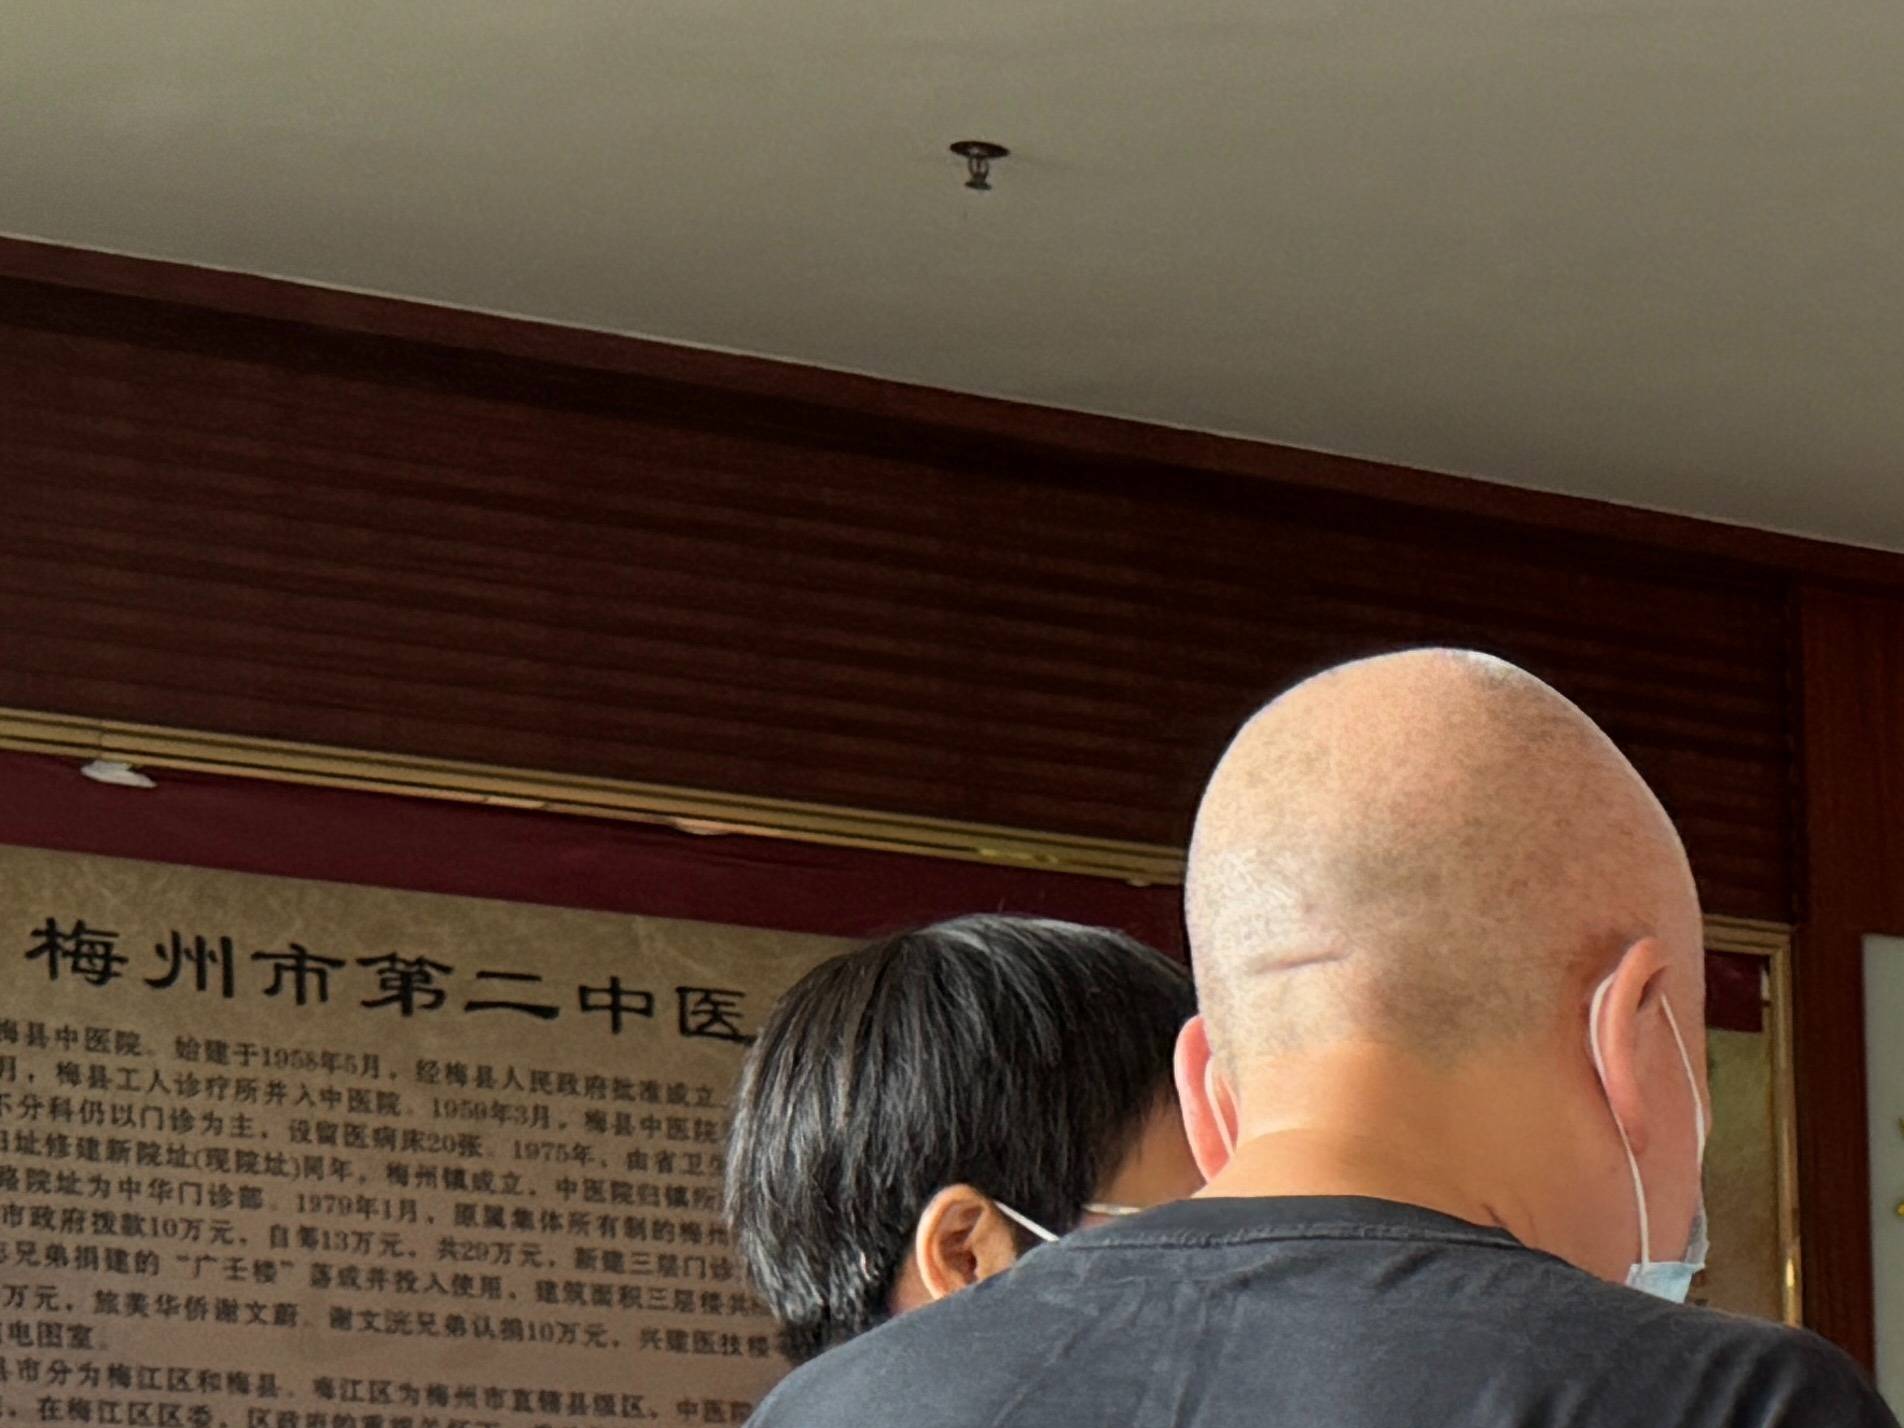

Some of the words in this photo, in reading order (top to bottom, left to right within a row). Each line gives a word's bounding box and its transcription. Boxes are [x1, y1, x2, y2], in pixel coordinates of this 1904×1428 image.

[25, 917, 758, 1046] 梅州市第二中医
